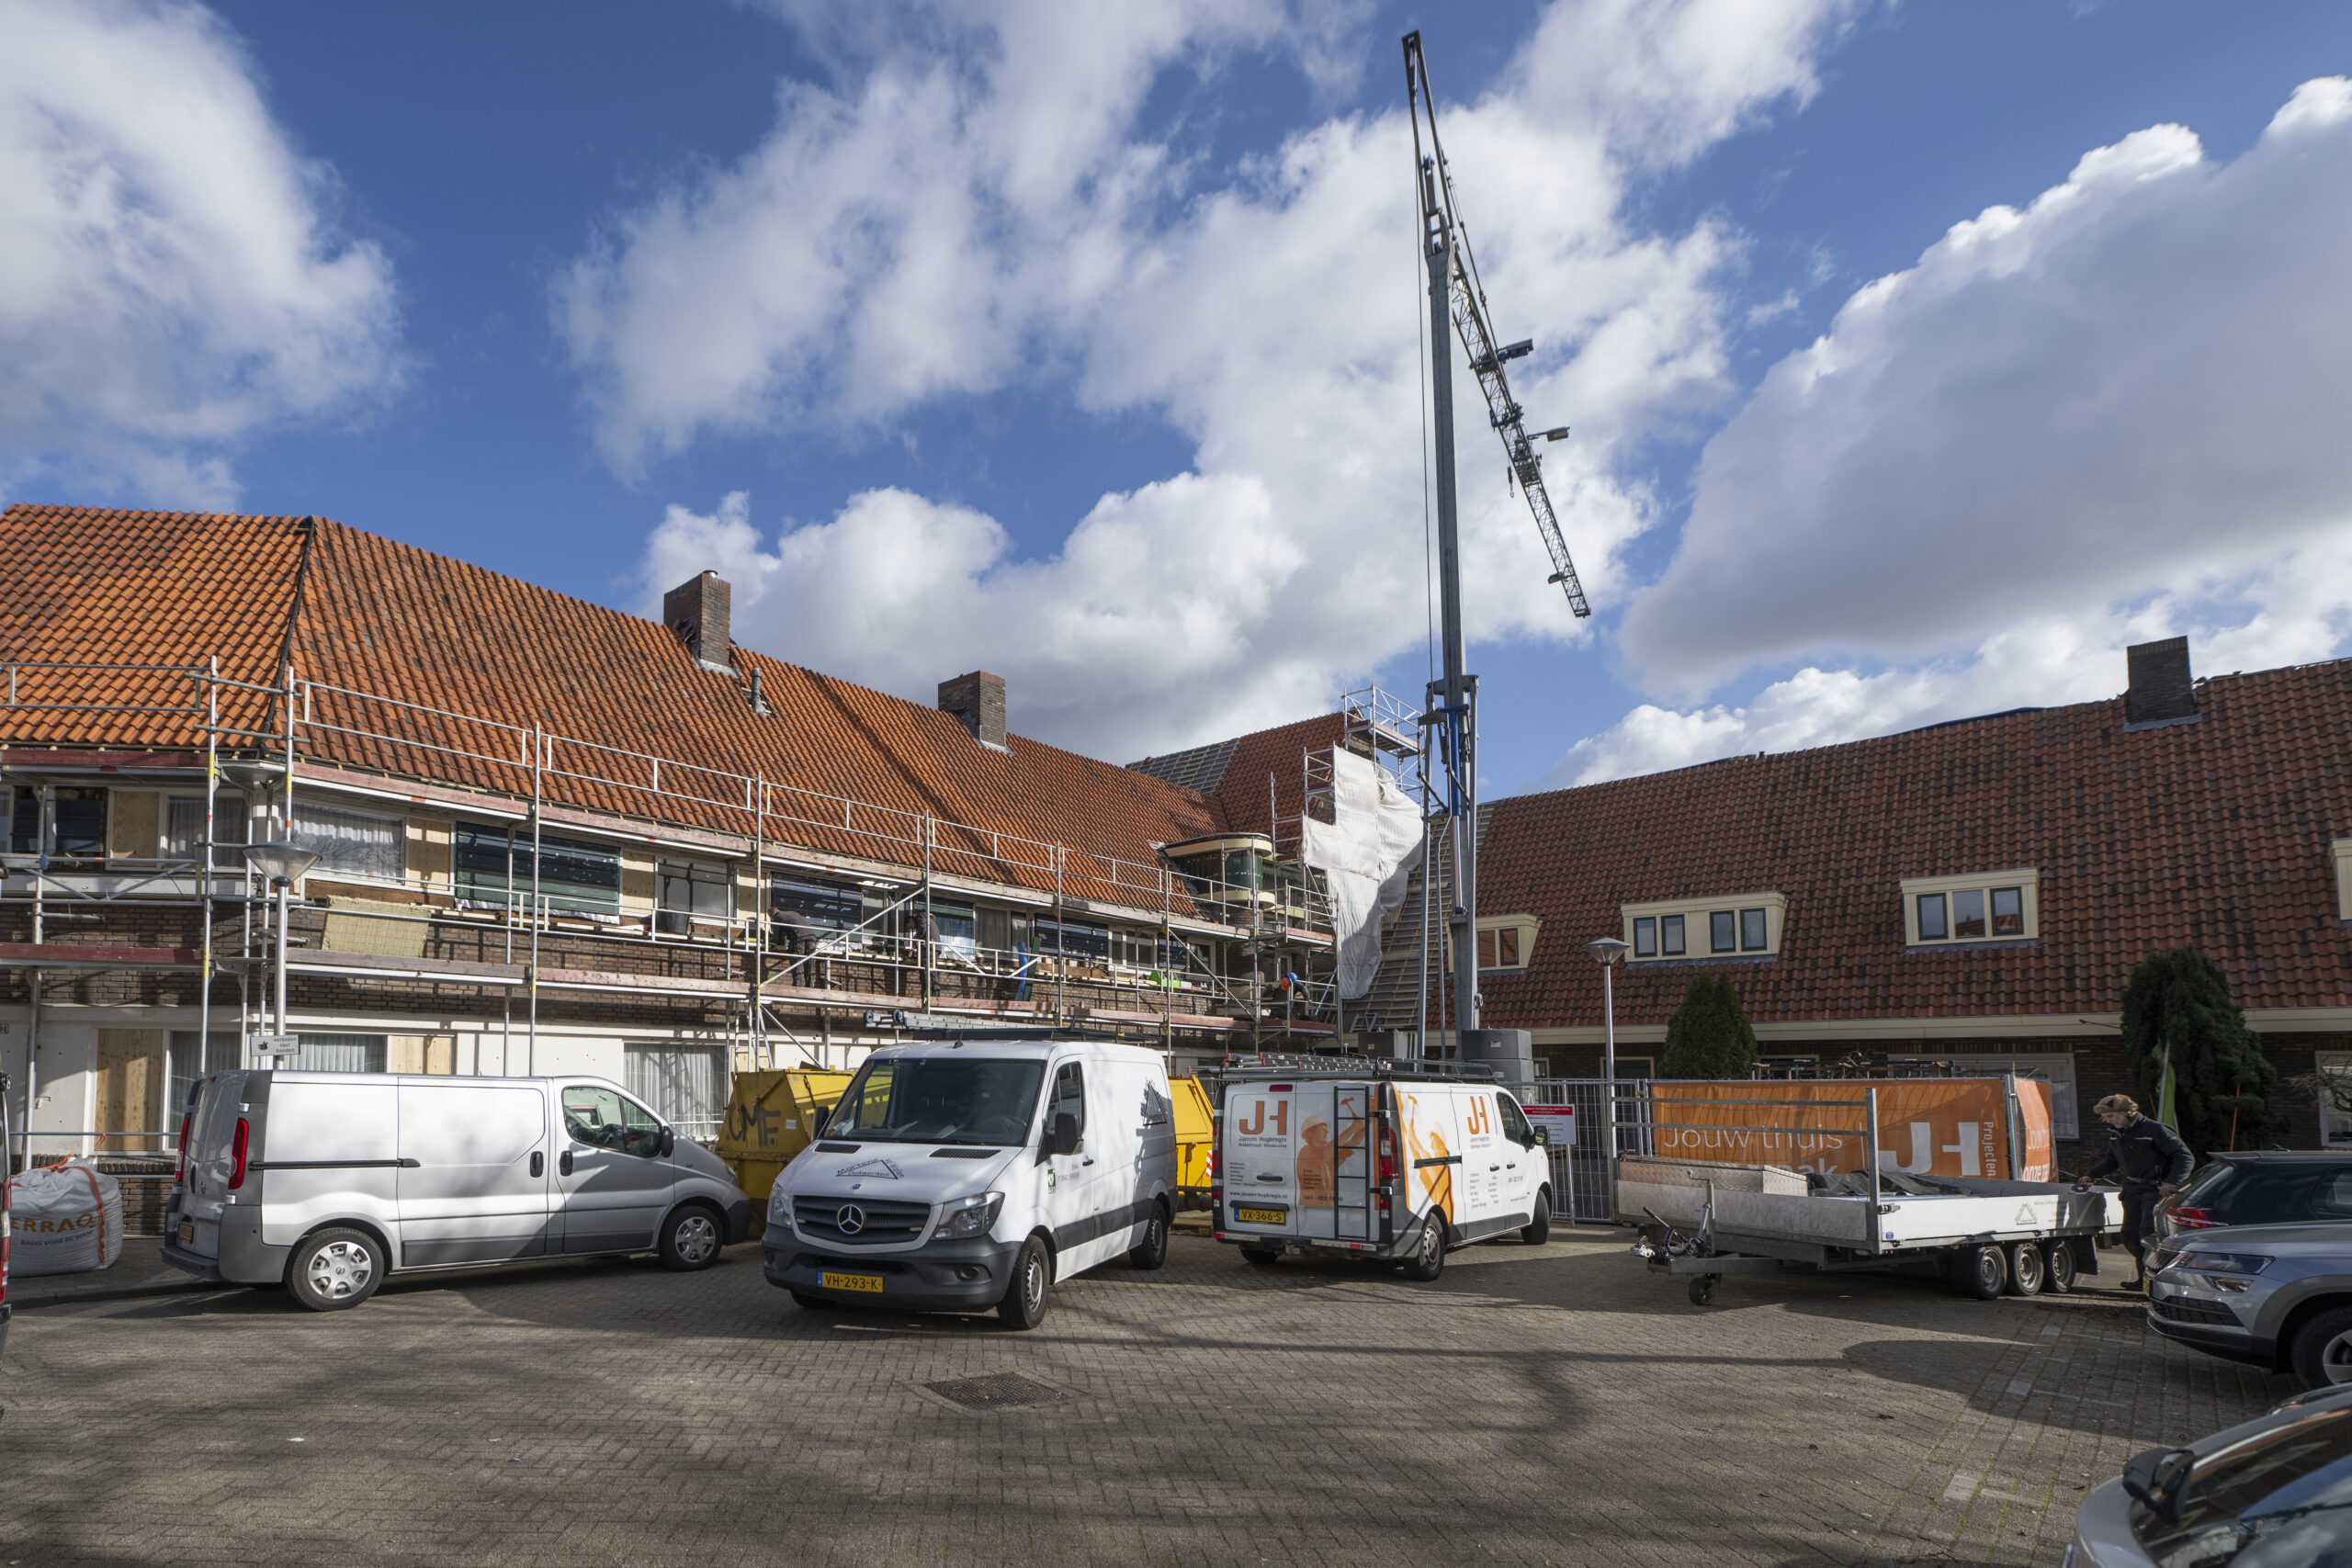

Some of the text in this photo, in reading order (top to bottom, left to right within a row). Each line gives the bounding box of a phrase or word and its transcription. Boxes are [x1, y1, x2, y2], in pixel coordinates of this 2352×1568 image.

[1239, 1100, 1288, 1135] JH
[1467, 1096, 1489, 1134] JH
[1763, 1122, 1843, 1149] thuis
[1983, 1121, 1997, 1177] Projecten
[1242, 1211, 1282, 1222] VX-366-S
[826, 1274, 878, 1290] VH-293-K
